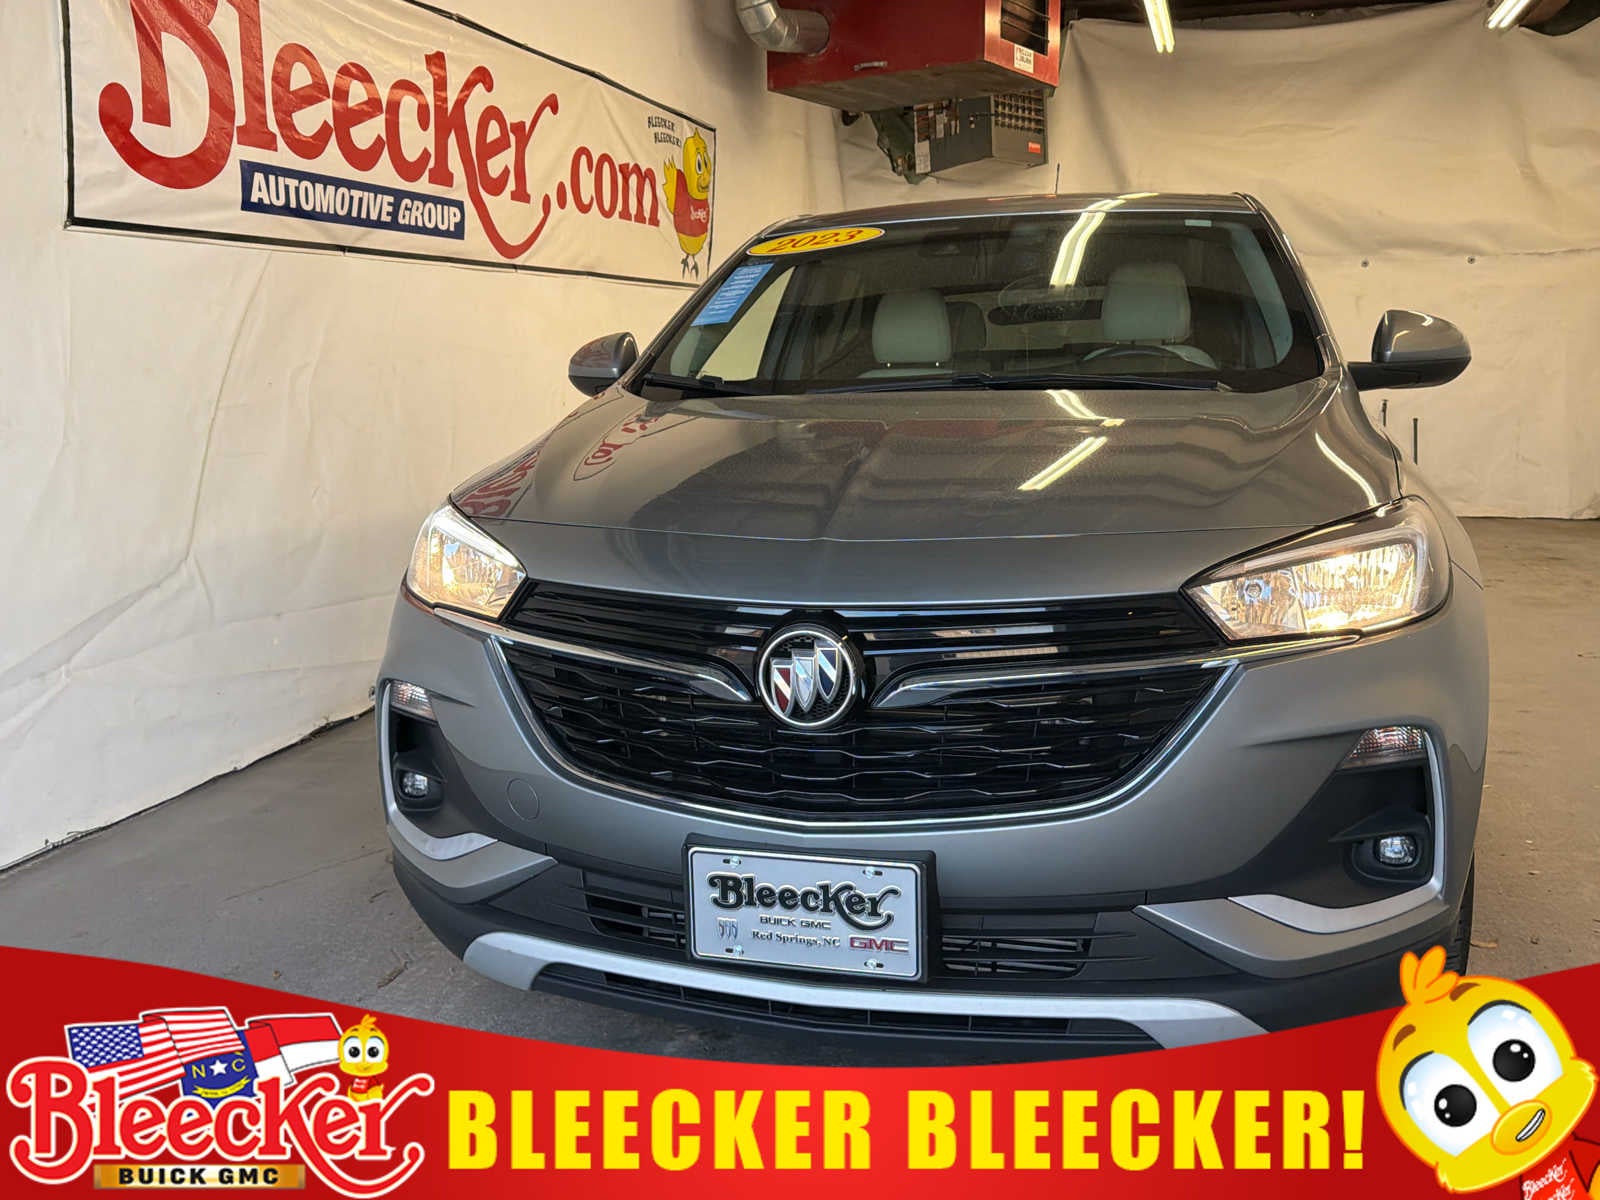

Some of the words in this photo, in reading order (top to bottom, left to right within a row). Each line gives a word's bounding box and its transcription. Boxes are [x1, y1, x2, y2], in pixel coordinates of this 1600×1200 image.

[250, 171, 394, 223] AUTOMOTIVE
[397, 198, 462, 232] GROUP
[767, 229, 864, 253] 2023
[760, 915, 797, 928] BUICK
[800, 918, 832, 930] GMC
[752, 930, 773, 940] Red
[775, 931, 821, 947] Springs,
[823, 936, 841, 947] NC
[849, 935, 910, 953] GMC
